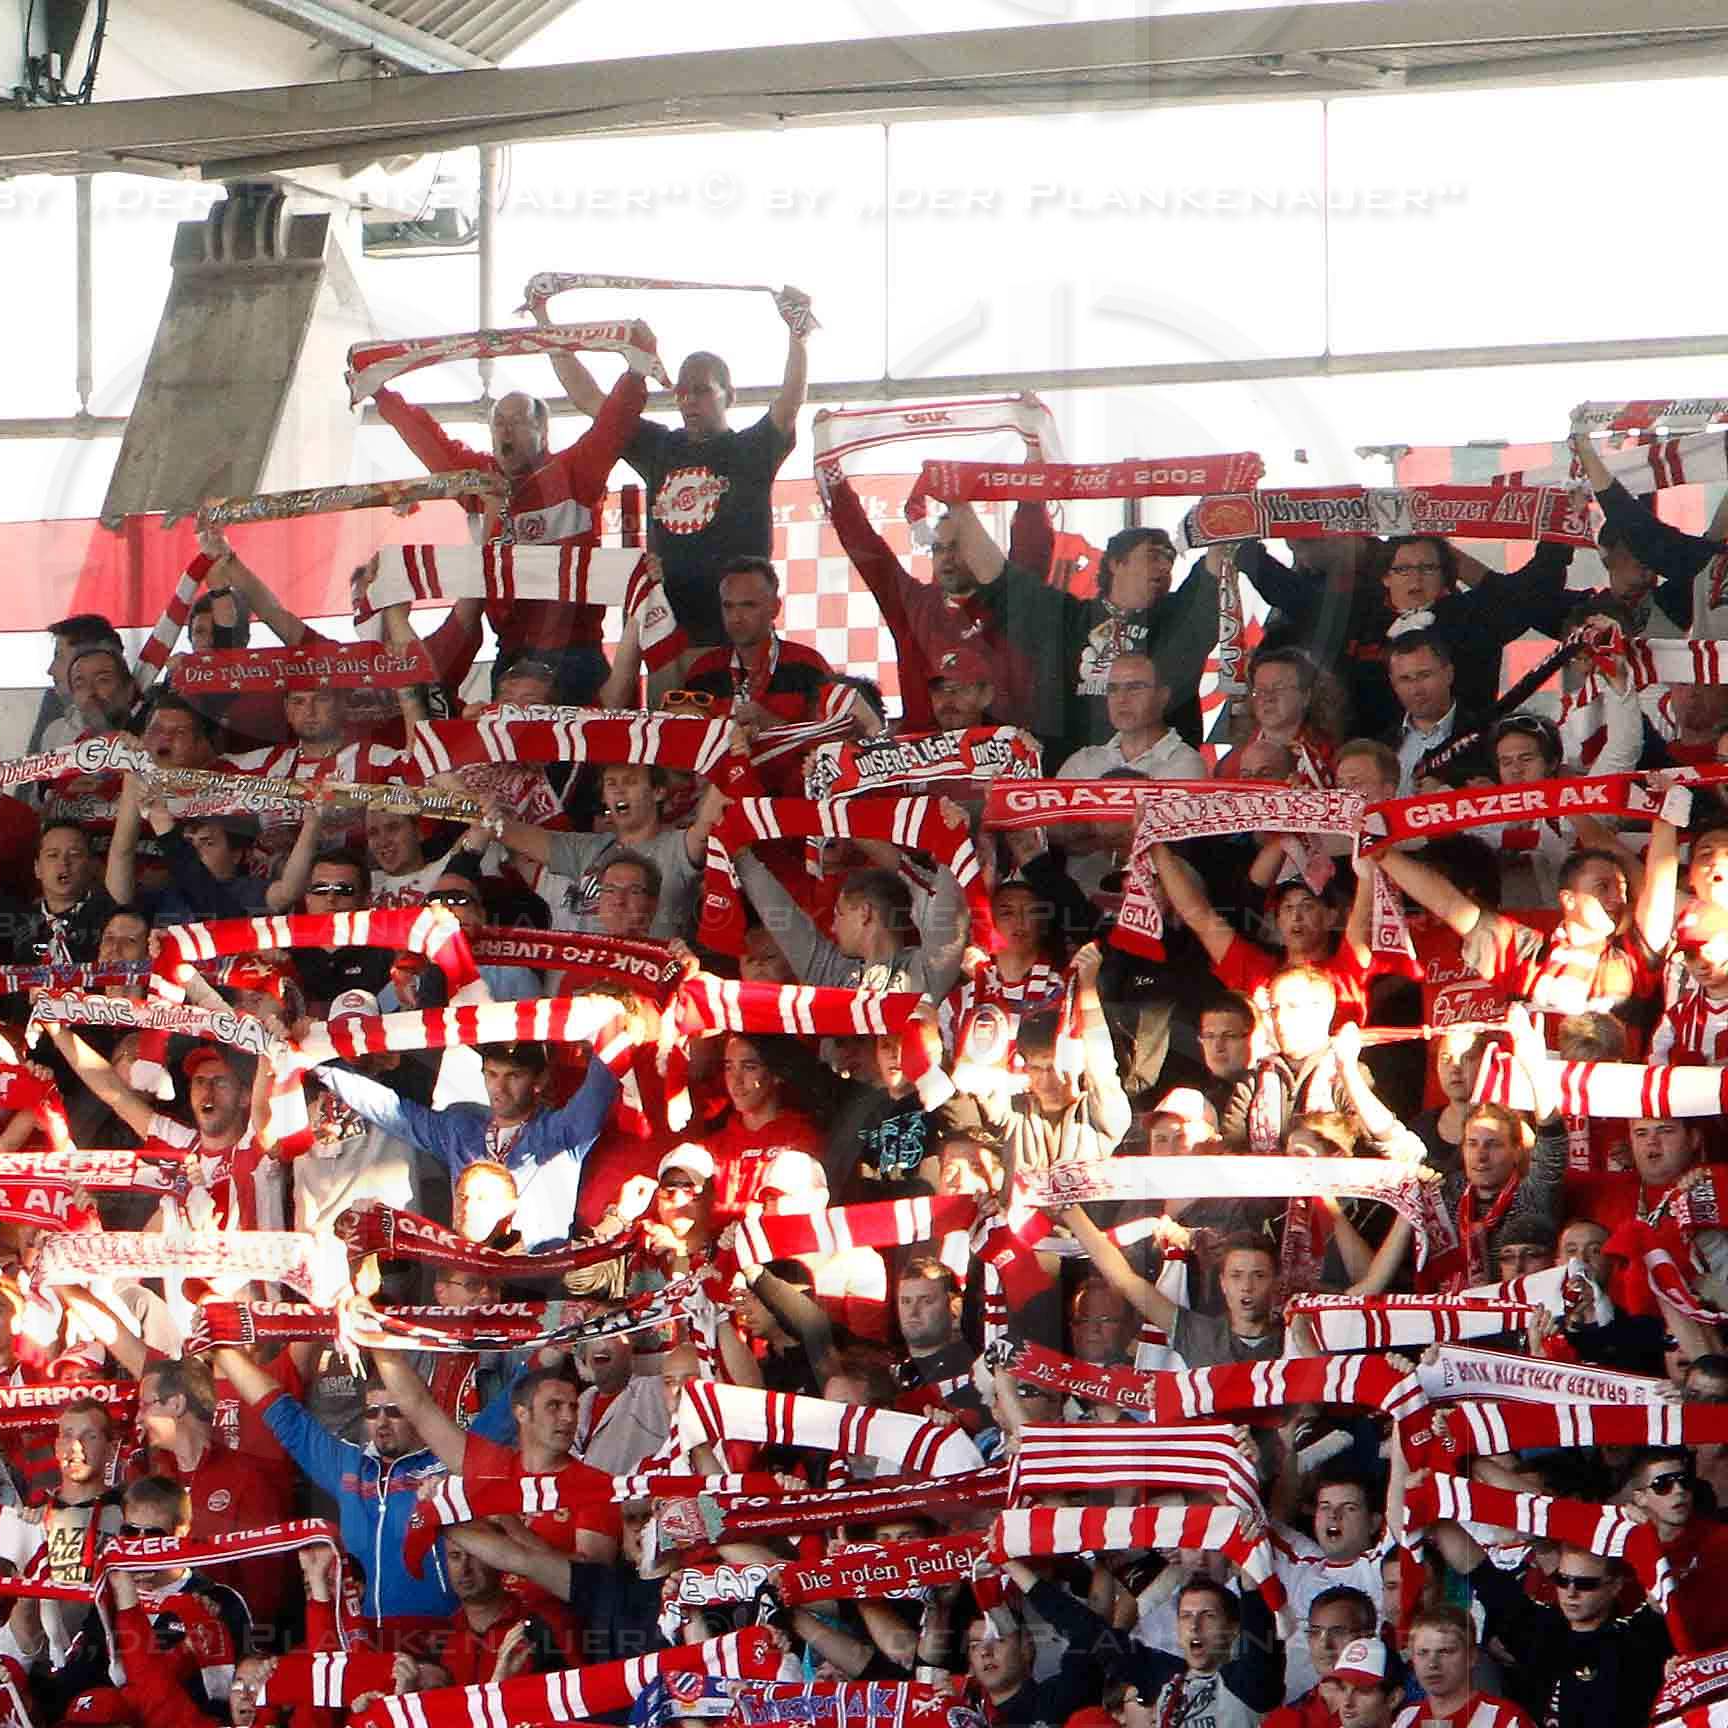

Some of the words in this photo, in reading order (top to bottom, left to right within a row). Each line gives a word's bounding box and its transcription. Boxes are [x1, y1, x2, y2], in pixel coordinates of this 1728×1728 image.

[977, 473, 1045, 488] 1902
[1133, 470, 1208, 486] 2002
[1270, 496, 1368, 523] Liverpool
[1410, 496, 1491, 523] Grazer
[1498, 494, 1534, 522] AK
[184, 668, 215, 684] Die
[220, 663, 271, 680] roten
[274, 658, 333, 679] Teufel
[335, 659, 369, 675] aus
[374, 654, 418, 674] Graz
[1404, 786, 1548, 830] GRAZER
[1558, 782, 1608, 807] AK
[1120, 903, 1158, 930] GAK
[562, 947, 590, 963] FC
[608, 953, 659, 979] GAK
[24, 1187, 74, 1218] AK
[1455, 1360, 1492, 1380] KLUB
[1495, 1366, 1564, 1388] ATHLETIK
[1566, 1376, 1630, 1402] GRAZER
[795, 1568, 832, 1592] Die
[839, 1562, 897, 1588] roten
[903, 1551, 972, 1578] Teufel
